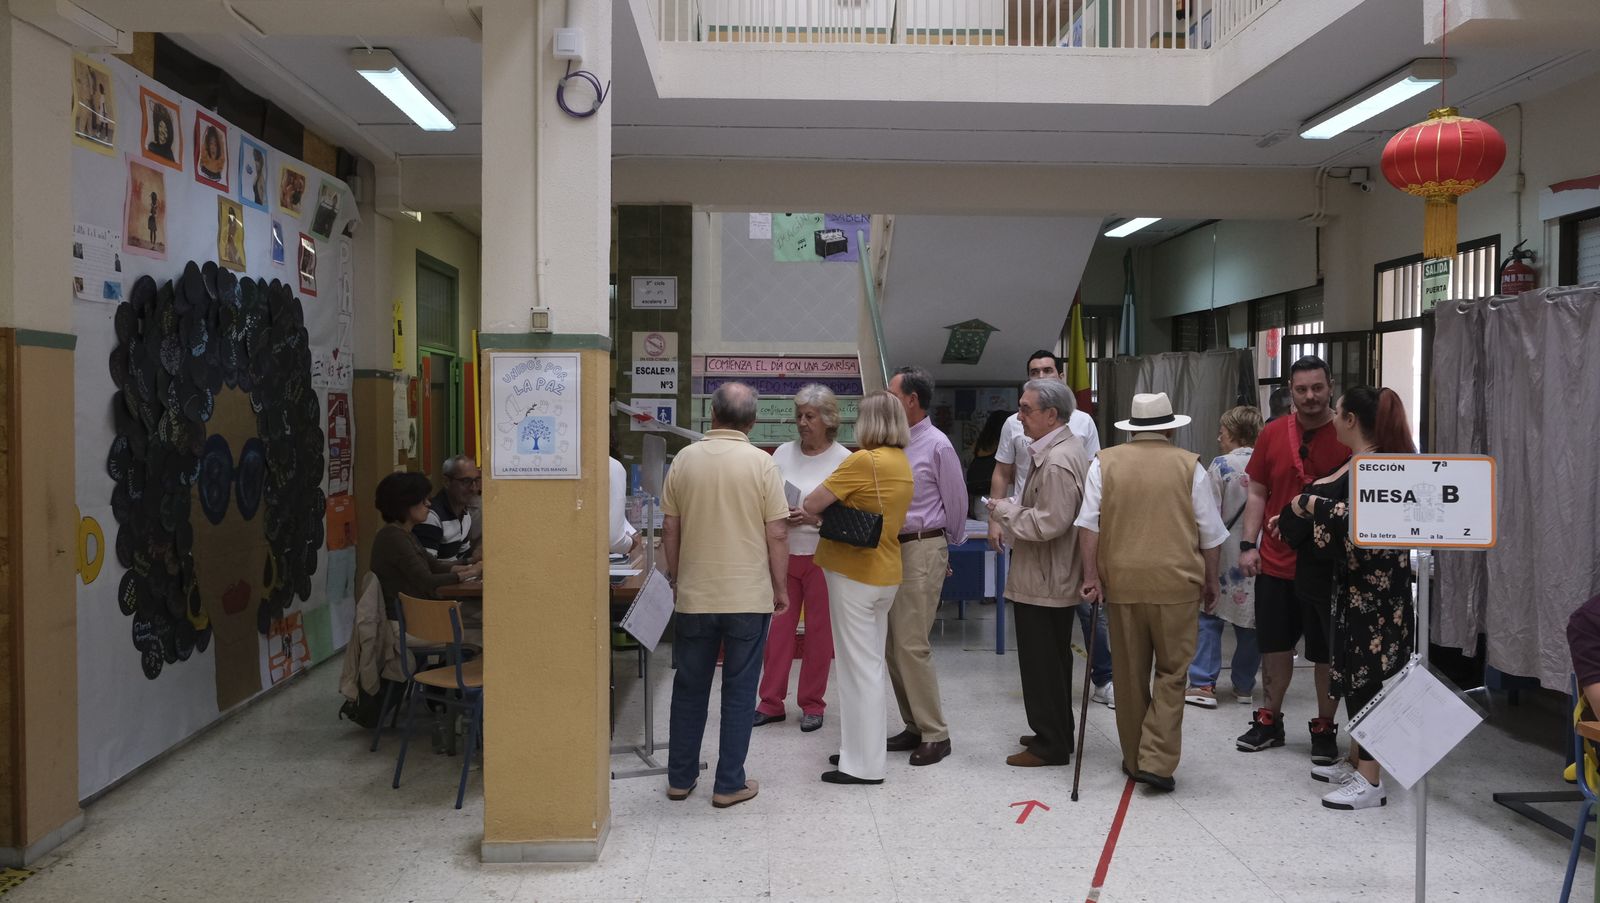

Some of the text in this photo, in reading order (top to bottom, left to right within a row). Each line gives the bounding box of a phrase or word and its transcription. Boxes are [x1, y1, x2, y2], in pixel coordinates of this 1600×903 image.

[1425, 262, 1448, 276] SALIDA
[1425, 284, 1447, 294] PUERTA
[502, 359, 568, 384] UNIDOS POR
[755, 360, 768, 371] EL
[785, 360, 800, 371] CON
[804, 361, 819, 370] UNA
[513, 377, 566, 396] LA PAZ
[1359, 461, 1448, 473] SECCIÓN 7ª
[1359, 485, 1460, 503] MESA B
[1410, 528, 1420, 536] M
[1463, 528, 1471, 536] Z
